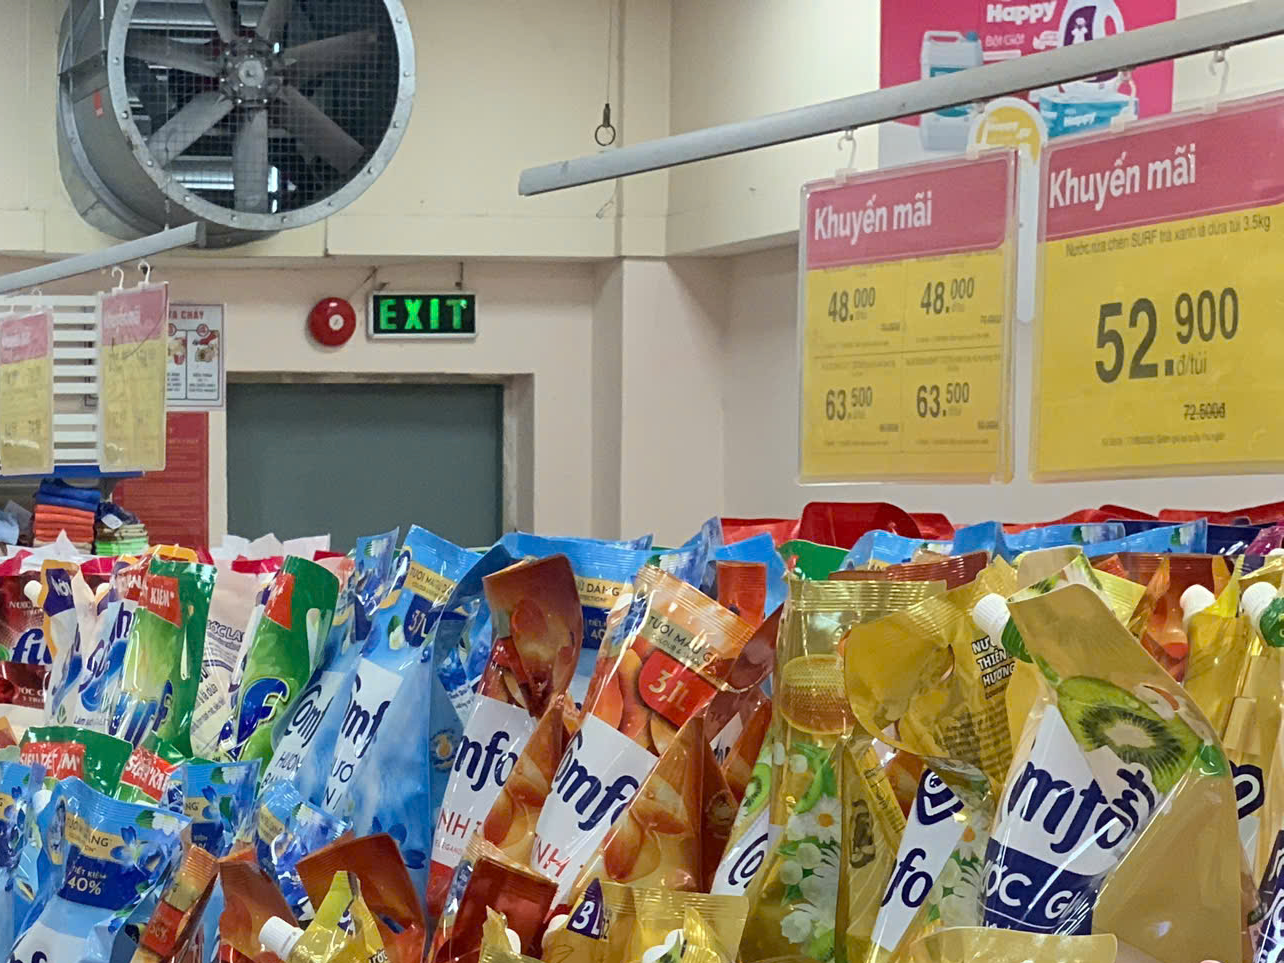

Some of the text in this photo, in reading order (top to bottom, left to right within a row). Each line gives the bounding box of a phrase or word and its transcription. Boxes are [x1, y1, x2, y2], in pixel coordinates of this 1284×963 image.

[986, 1, 1057, 24] Happy
[1048, 144, 1196, 210] Khuyến mãi
[815, 191, 932, 244] Khuyến mãi
[1131, 229, 1157, 249] SURF
[1243, 214, 1271, 232] 3.5kg
[379, 298, 468, 330] EXIT
[67, 876, 101, 895] 40%
